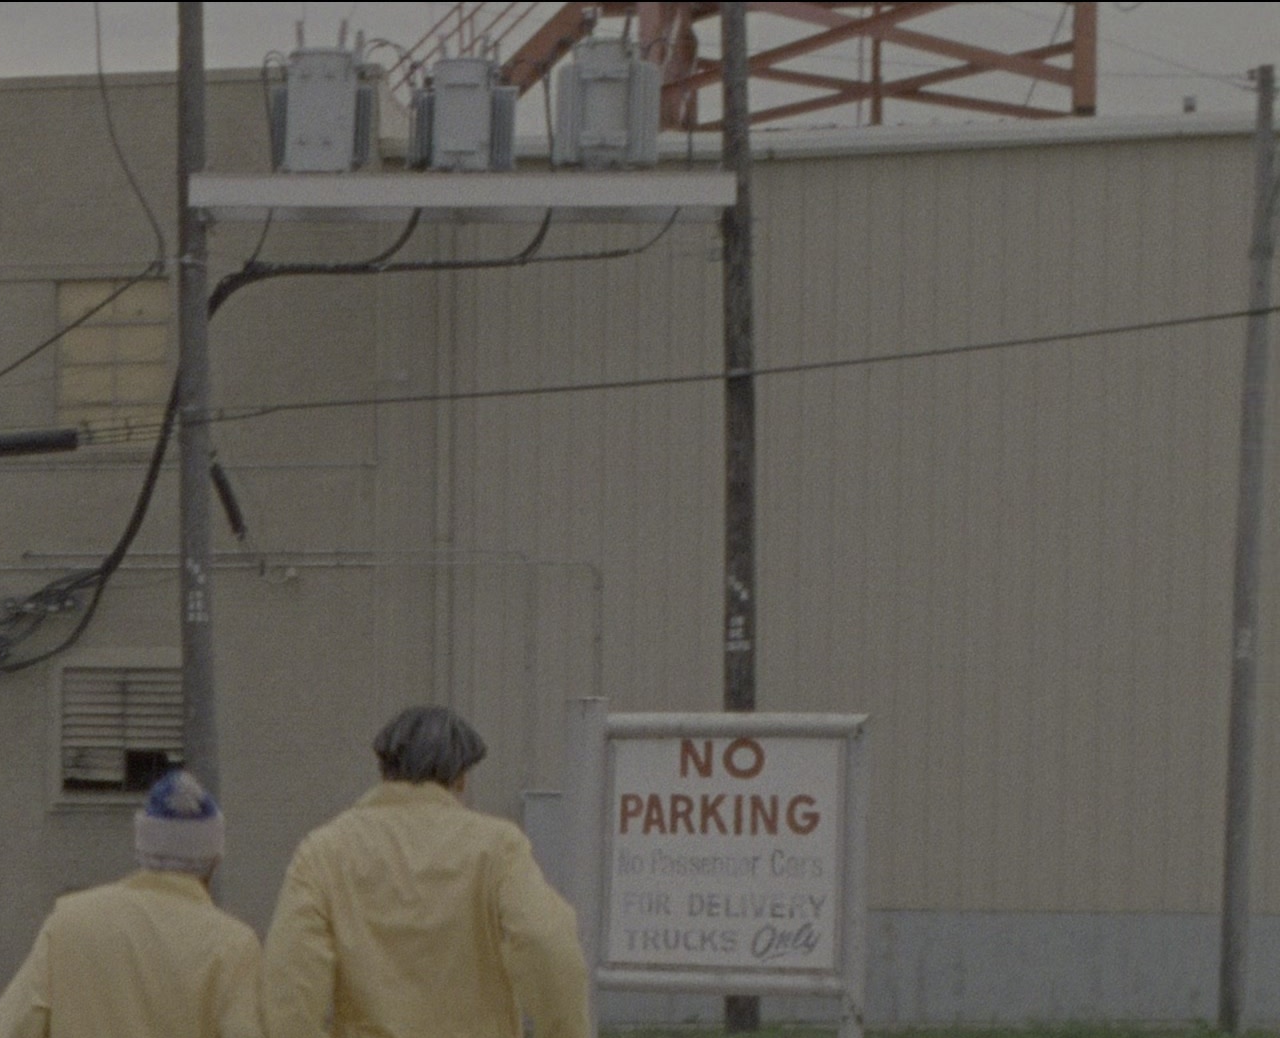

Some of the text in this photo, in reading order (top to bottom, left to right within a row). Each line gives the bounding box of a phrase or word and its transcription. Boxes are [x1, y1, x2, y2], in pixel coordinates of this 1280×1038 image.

[679, 736, 765, 779] NO
[618, 793, 821, 836] PARKING
[622, 891, 828, 919] FOR DELIVERY
[624, 921, 822, 959] TRUCKS Only
